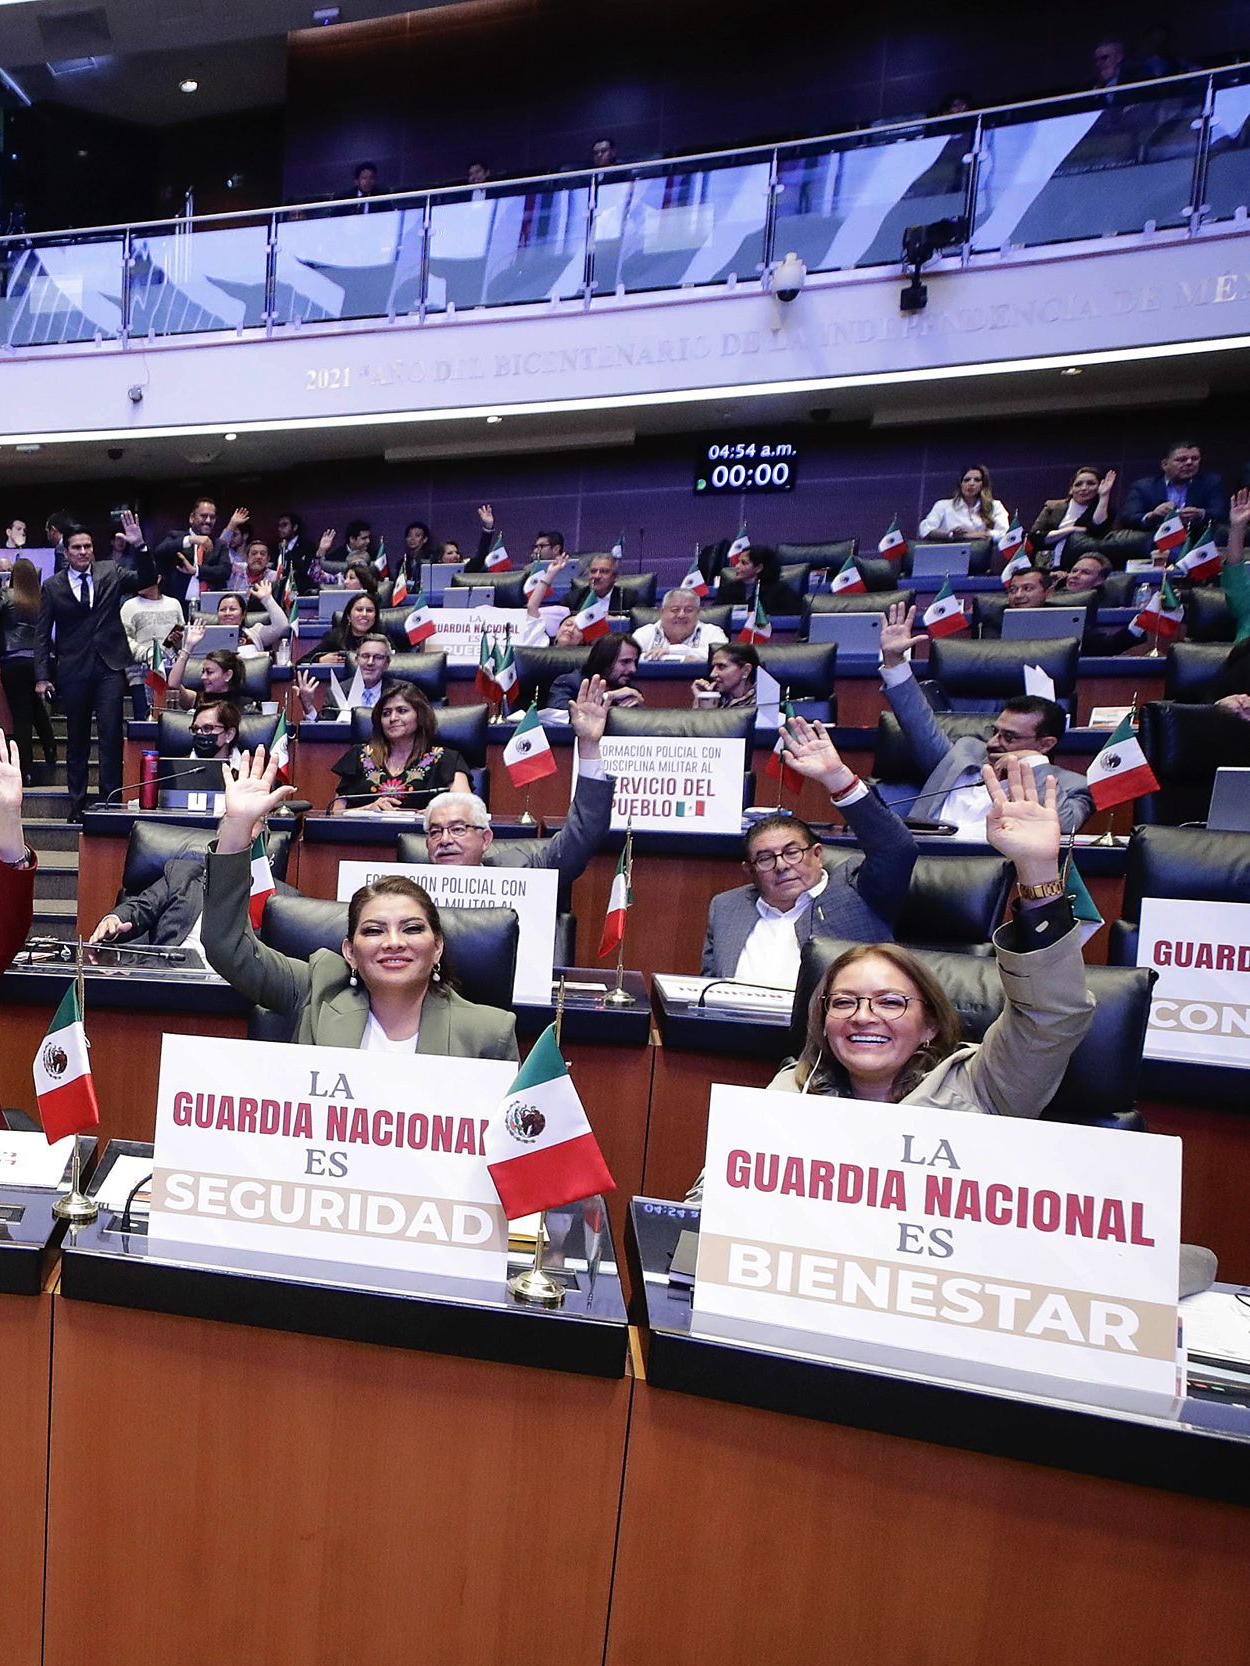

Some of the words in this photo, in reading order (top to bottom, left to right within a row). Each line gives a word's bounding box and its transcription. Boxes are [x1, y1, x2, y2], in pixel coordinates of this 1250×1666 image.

[305, 367, 351, 390] 2021
[719, 331, 760, 358] DE
[708, 443, 756, 460] 04:54
[760, 444, 797, 458] a.m.
[712, 462, 790, 488] 00:00
[437, 623, 471, 634] UARDIA
[469, 614, 482, 623] LA
[468, 634, 480, 642] ES
[656, 745, 699, 758] POLICIAL
[701, 746, 722, 759] CON
[603, 759, 655, 773] DISCIPLINA
[658, 760, 698, 773] MILITAR
[701, 761, 714, 774] AL
[614, 776, 677, 796] RVICIO
[683, 778, 716, 797] DEL
[441, 876, 497, 896] POLICIAL
[501, 879, 527, 897] CON
[309, 1071, 354, 1100] LA
[173, 1091, 313, 1139] GUARDIA
[304, 1149, 348, 1177] ES
[901, 1135, 961, 1170] LA
[164, 1173, 494, 1245] SEGURIDAD
[726, 1149, 907, 1212] GUARDIA
[924, 1174, 1156, 1248] NACIONAL
[896, 1223, 954, 1258] ES
[727, 1242, 1141, 1353] BIENESTAR
